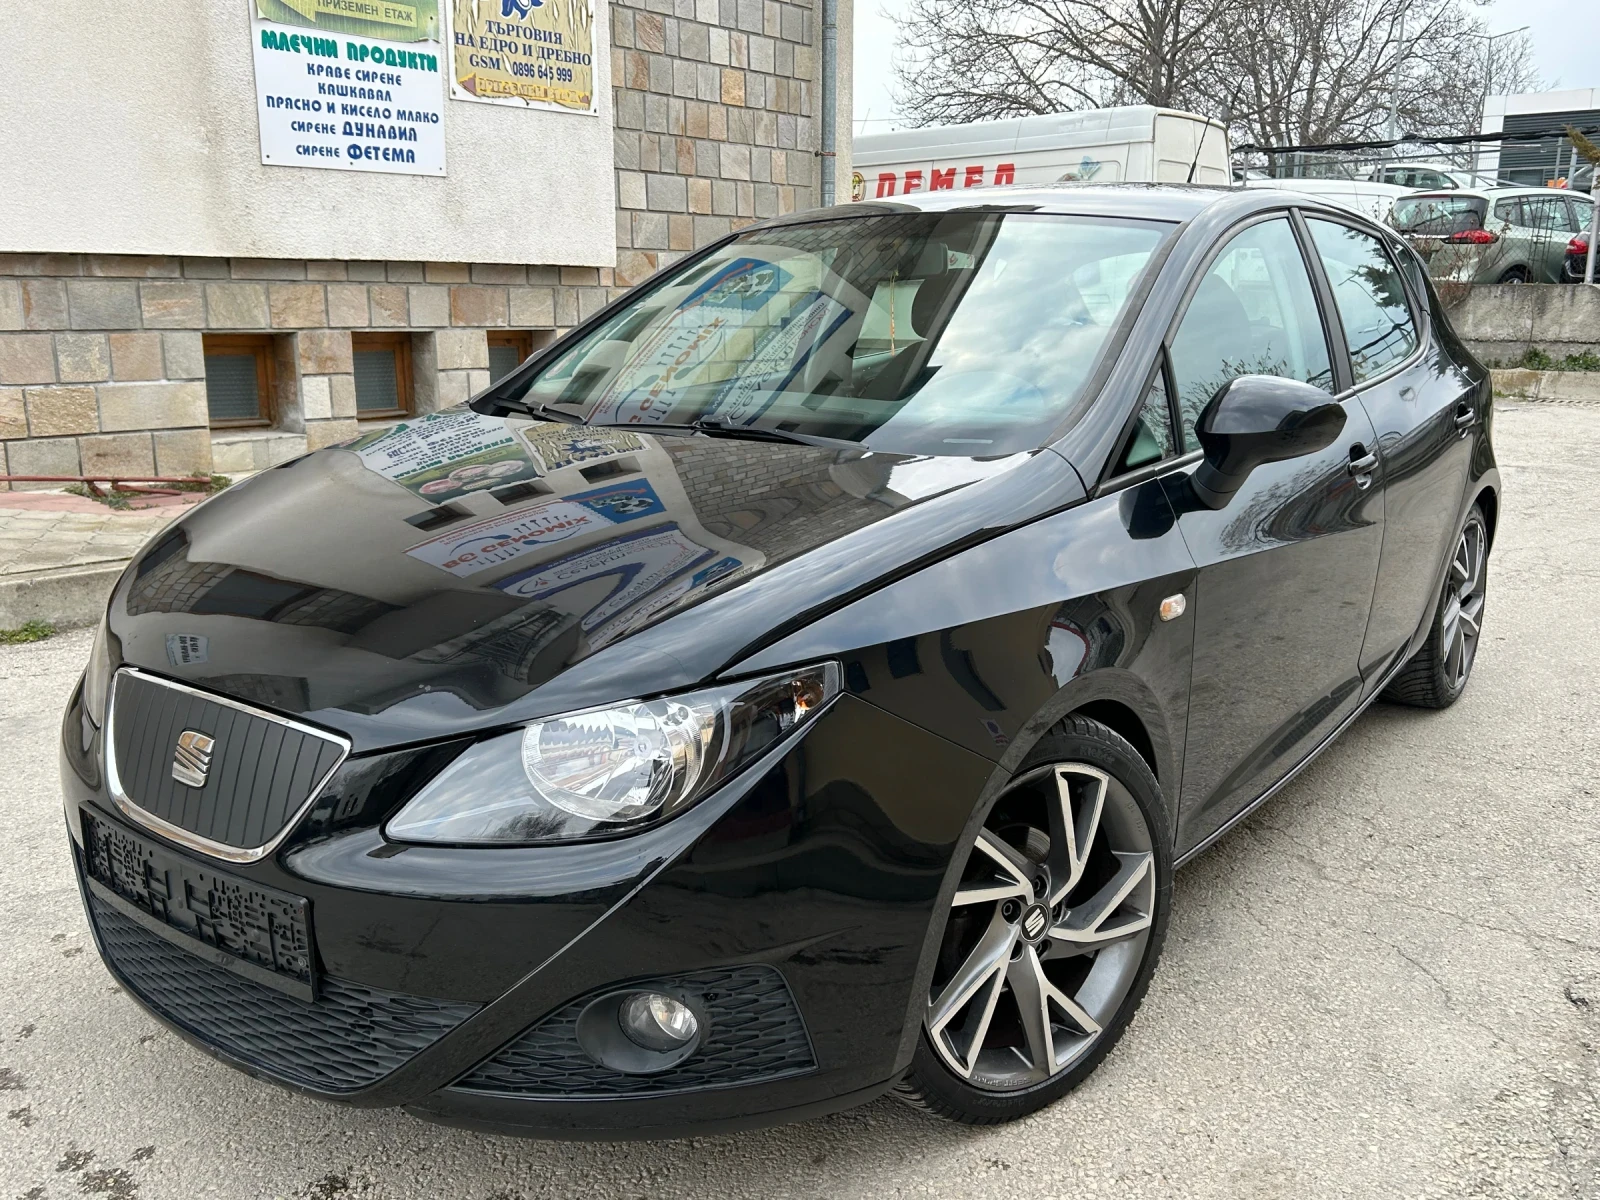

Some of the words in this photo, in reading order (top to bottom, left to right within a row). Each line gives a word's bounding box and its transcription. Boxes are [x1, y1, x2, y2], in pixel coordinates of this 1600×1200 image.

[317, 0, 379, 16] ПРИЗЕМЕН
[384, 7, 413, 22] ЕТАЖ
[485, 19, 562, 45] ТЪРГОВИЯ
[260, 28, 339, 59] МЛЕЧНИ
[346, 41, 438, 73] ПРОДУКТИ
[455, 32, 476, 47] НА
[479, 36, 519, 55] ЕДРО
[522, 43, 533, 57] И
[537, 45, 592, 66] ДРЕБНО
[307, 62, 351, 80] КРАВЕ
[355, 69, 402, 86] СИРЕНЕ
[469, 53, 501, 71] GSM
[512, 61, 535, 79] 0896
[537, 65, 554, 81] 645
[556, 66, 573, 83] 999
[318, 82, 393, 102] КАШКАВАЛ
[266, 95, 322, 113] ПРЯСНО
[326, 101, 336, 114] И
[341, 103, 392, 120] КИСЕЛО
[396, 109, 440, 124] МЛЯКО
[290, 120, 337, 135] СИРЕНЕ
[295, 144, 341, 158] СИРЕНЕ
[347, 143, 416, 164] ФЕТЕМА
